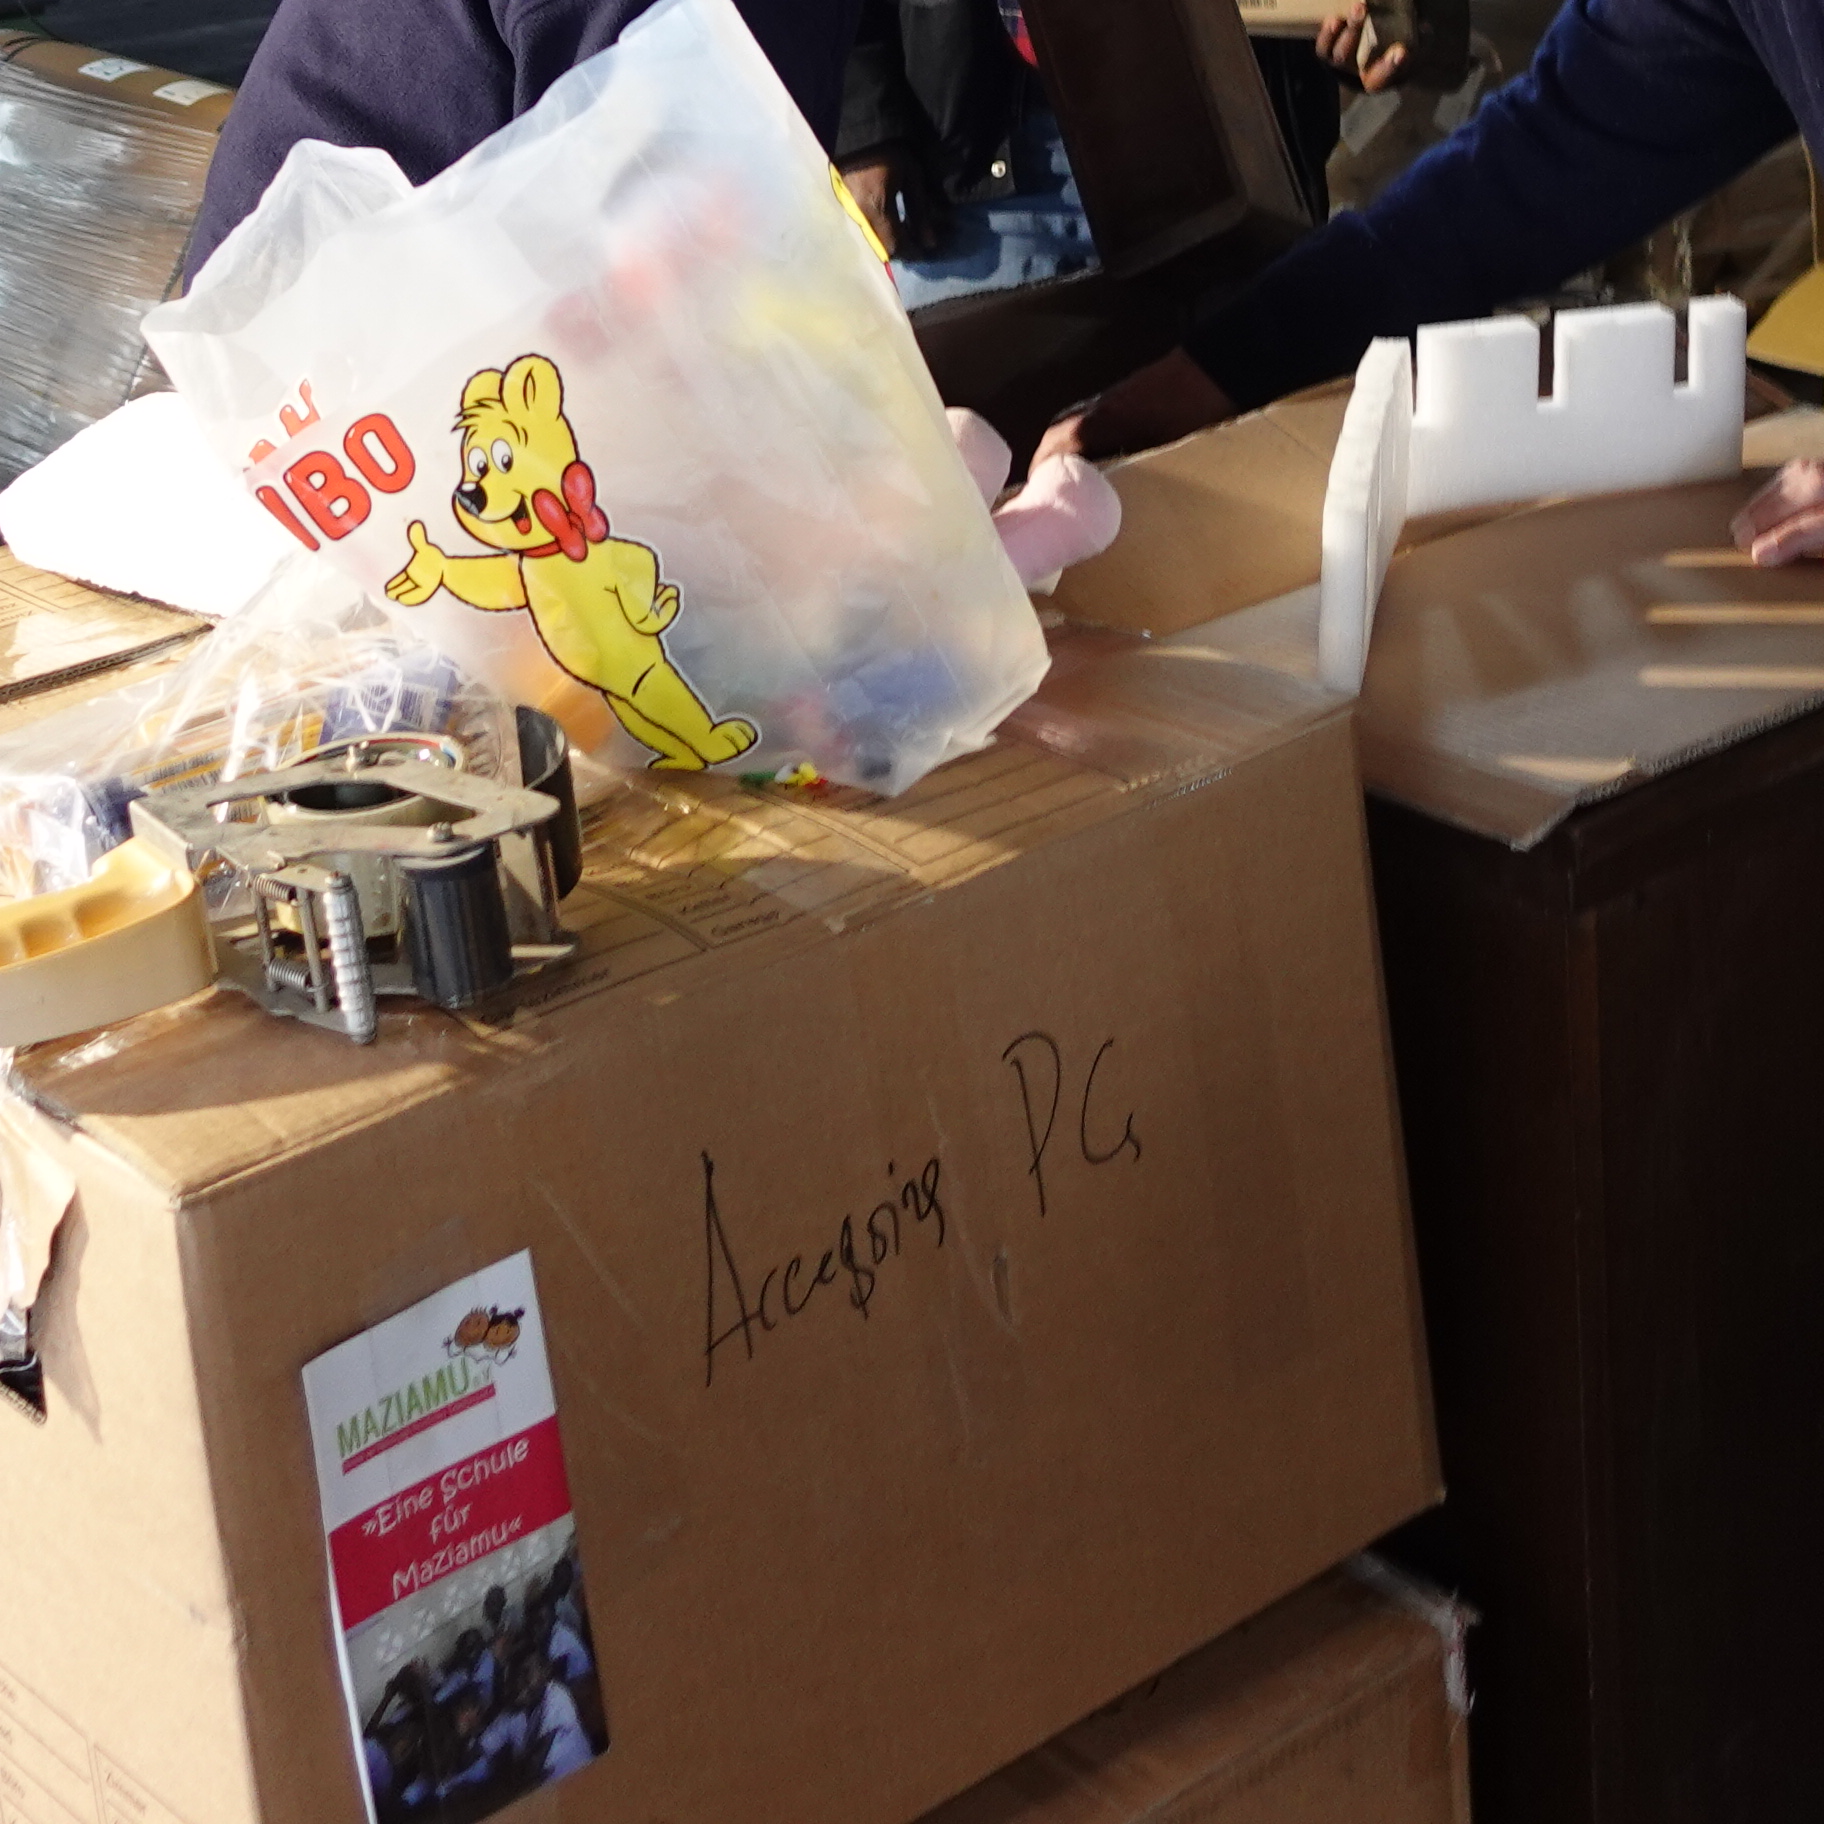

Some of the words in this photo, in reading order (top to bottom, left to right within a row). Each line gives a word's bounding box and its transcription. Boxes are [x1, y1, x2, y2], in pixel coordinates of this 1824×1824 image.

[337, 1357, 470, 1458] MAZIAMU
[439, 1434, 531, 1506] Schule
[428, 1500, 474, 1544] für
